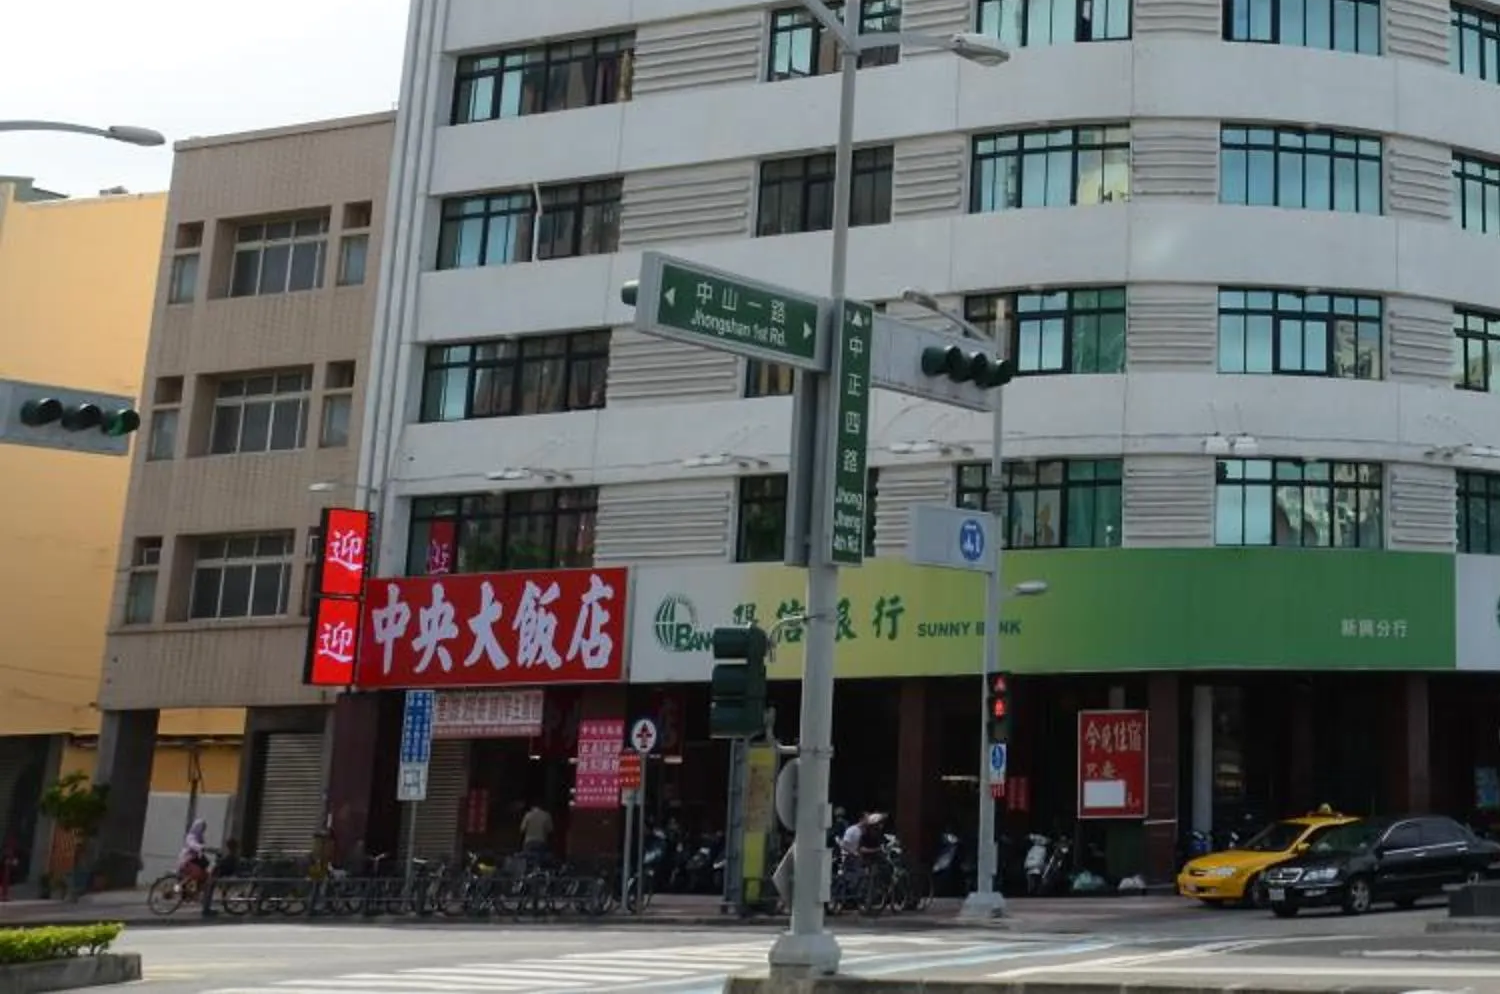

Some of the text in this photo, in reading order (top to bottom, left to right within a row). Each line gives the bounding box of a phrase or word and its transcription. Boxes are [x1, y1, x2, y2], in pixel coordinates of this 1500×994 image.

[691, 309, 750, 337] Jhongshan
[697, 281, 785, 324] 中山一路
[843, 337, 863, 473] 中正四路
[835, 486, 862, 510] Jhong
[329, 530, 363, 571] 迎
[318, 622, 353, 663] 迎
[372, 573, 614, 675] 中央大飯店
[917, 621, 1022, 638] SUNNY BNK
